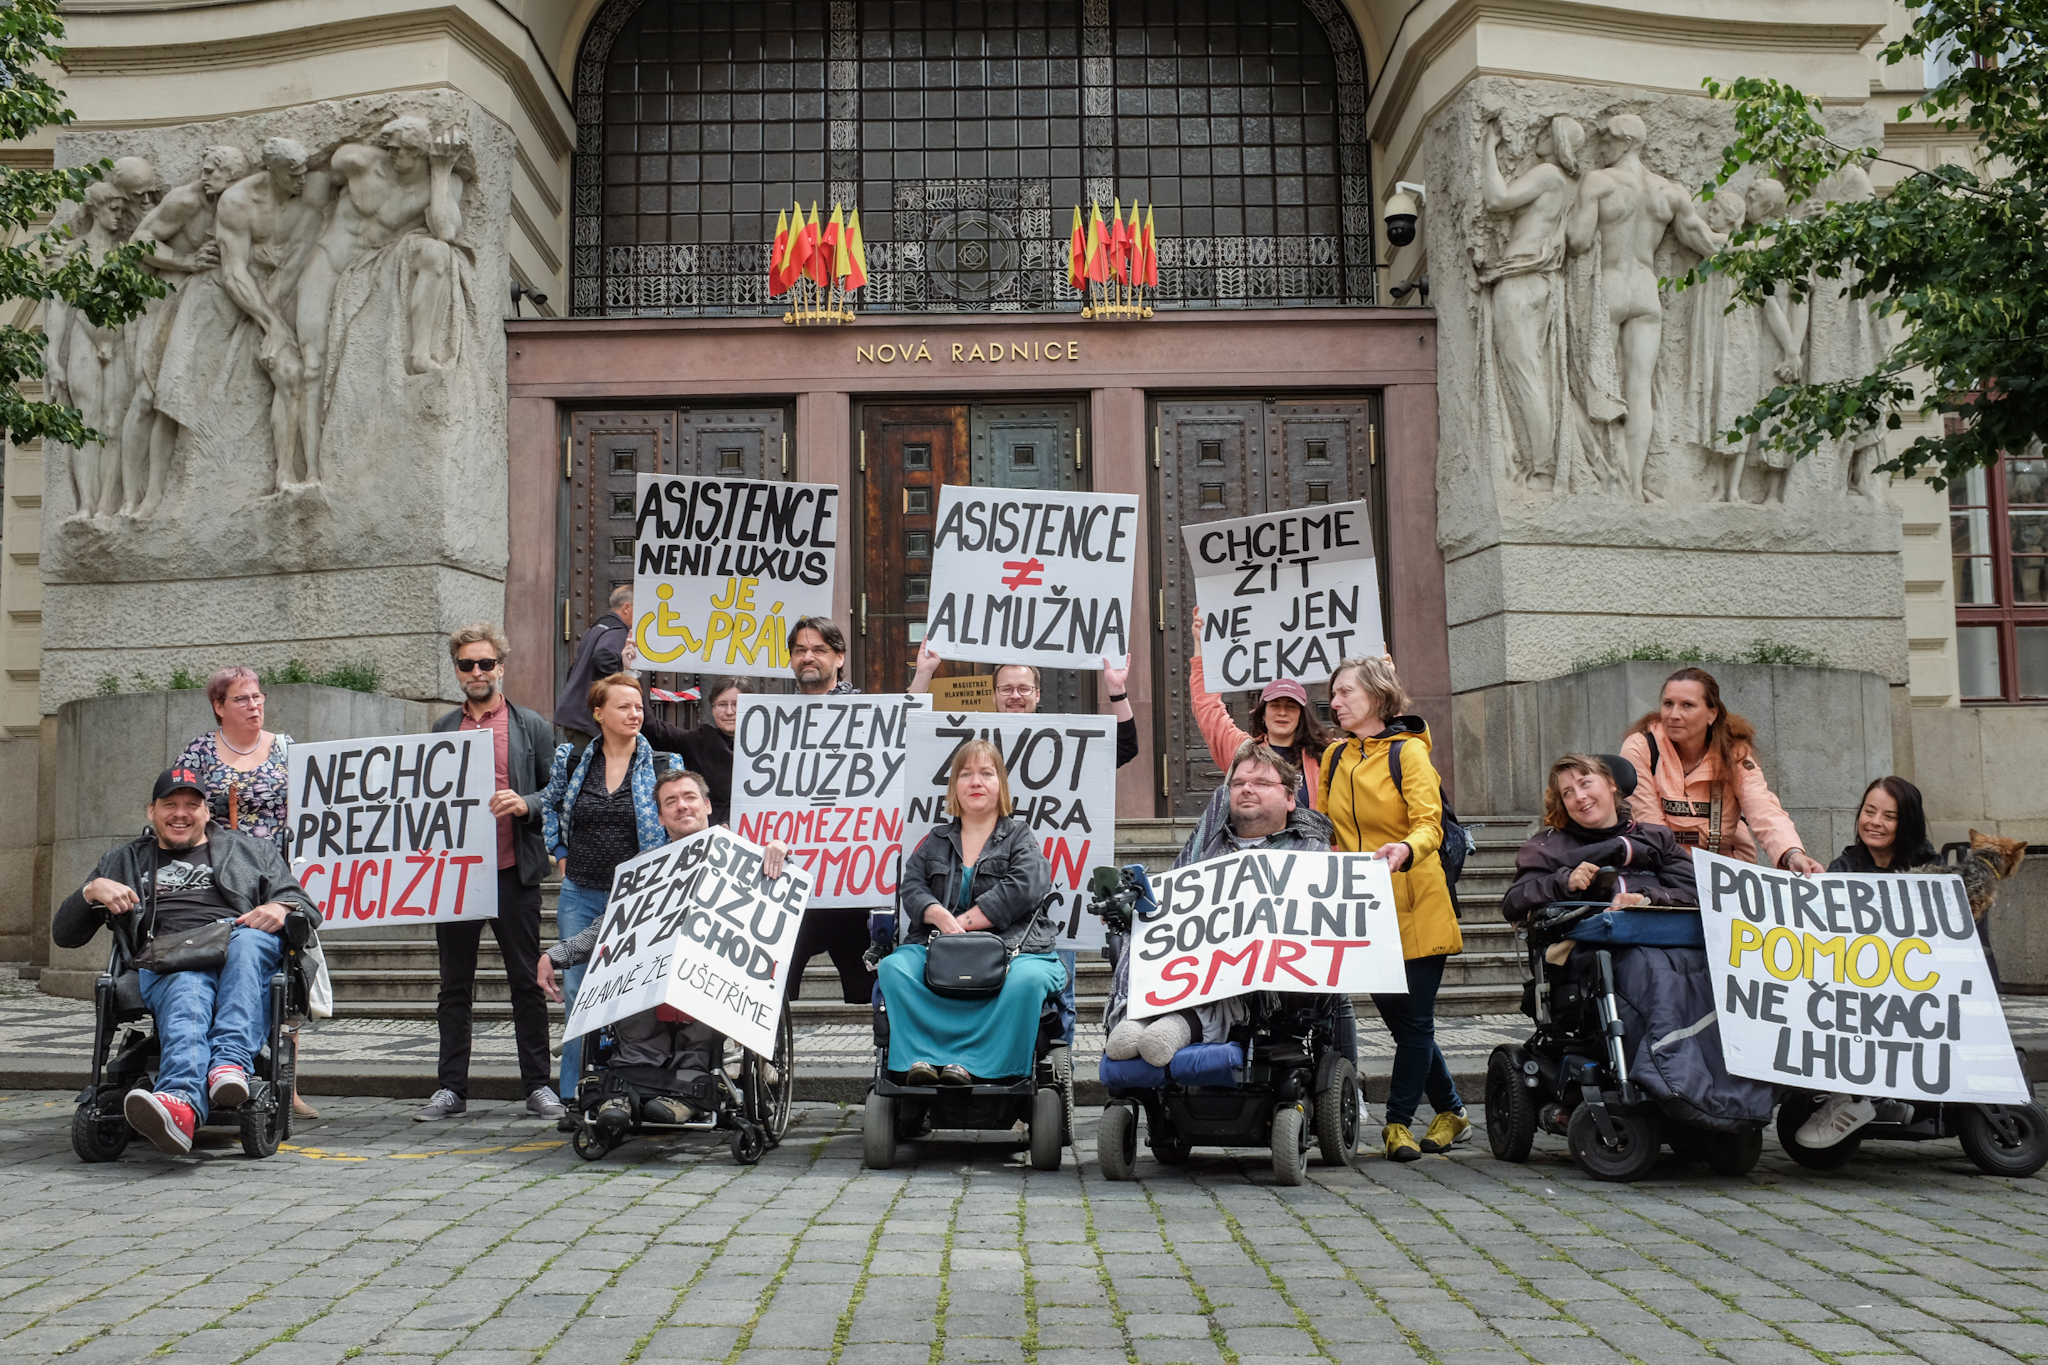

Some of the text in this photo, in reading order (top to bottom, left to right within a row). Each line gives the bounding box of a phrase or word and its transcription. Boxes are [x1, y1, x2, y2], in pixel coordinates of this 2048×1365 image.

[856, 339, 1079, 363] NOVÁ RADNICE
[635, 480, 839, 549] ASISTENCE
[934, 501, 1135, 562] ASISTENCE
[1200, 511, 1360, 564] CHCEME
[638, 536, 828, 586] NENÍ LUXUS
[710, 577, 760, 611] JE
[926, 584, 1127, 656] ALMUŽNA
[1204, 585, 1359, 642] NE JEN
[701, 601, 810, 669] PRÁV
[1222, 630, 1355, 687] ČEKAT
[944, 688, 993, 698] HLAVNÍHO MĚST
[952, 680, 988, 689] MAGISTRÁT
[301, 740, 471, 808] NECHCI
[743, 748, 906, 798] SLUŽBY
[295, 797, 480, 859] PŘEŽÍVAT
[737, 807, 904, 847] NEOMEZEN
[299, 847, 484, 921] CHCI ŽÍT
[598, 866, 788, 945] NEMŮŽU
[611, 833, 809, 916] BEZ ASISTENCE
[1307, 854, 1376, 901] JE
[1710, 861, 1975, 940] POTŘEBUJU
[589, 932, 637, 974] NA
[1139, 897, 1382, 961] SOCIÁLNÍ
[1729, 918, 1941, 992] POMOC
[572, 953, 774, 1031] HLAVNĚ ŽE UŠETŘÍME
[1145, 939, 1371, 1007] SMRT
[1726, 974, 1973, 1041] NE ČEKACÍ
[1773, 1027, 1951, 1095] LHŮTU
